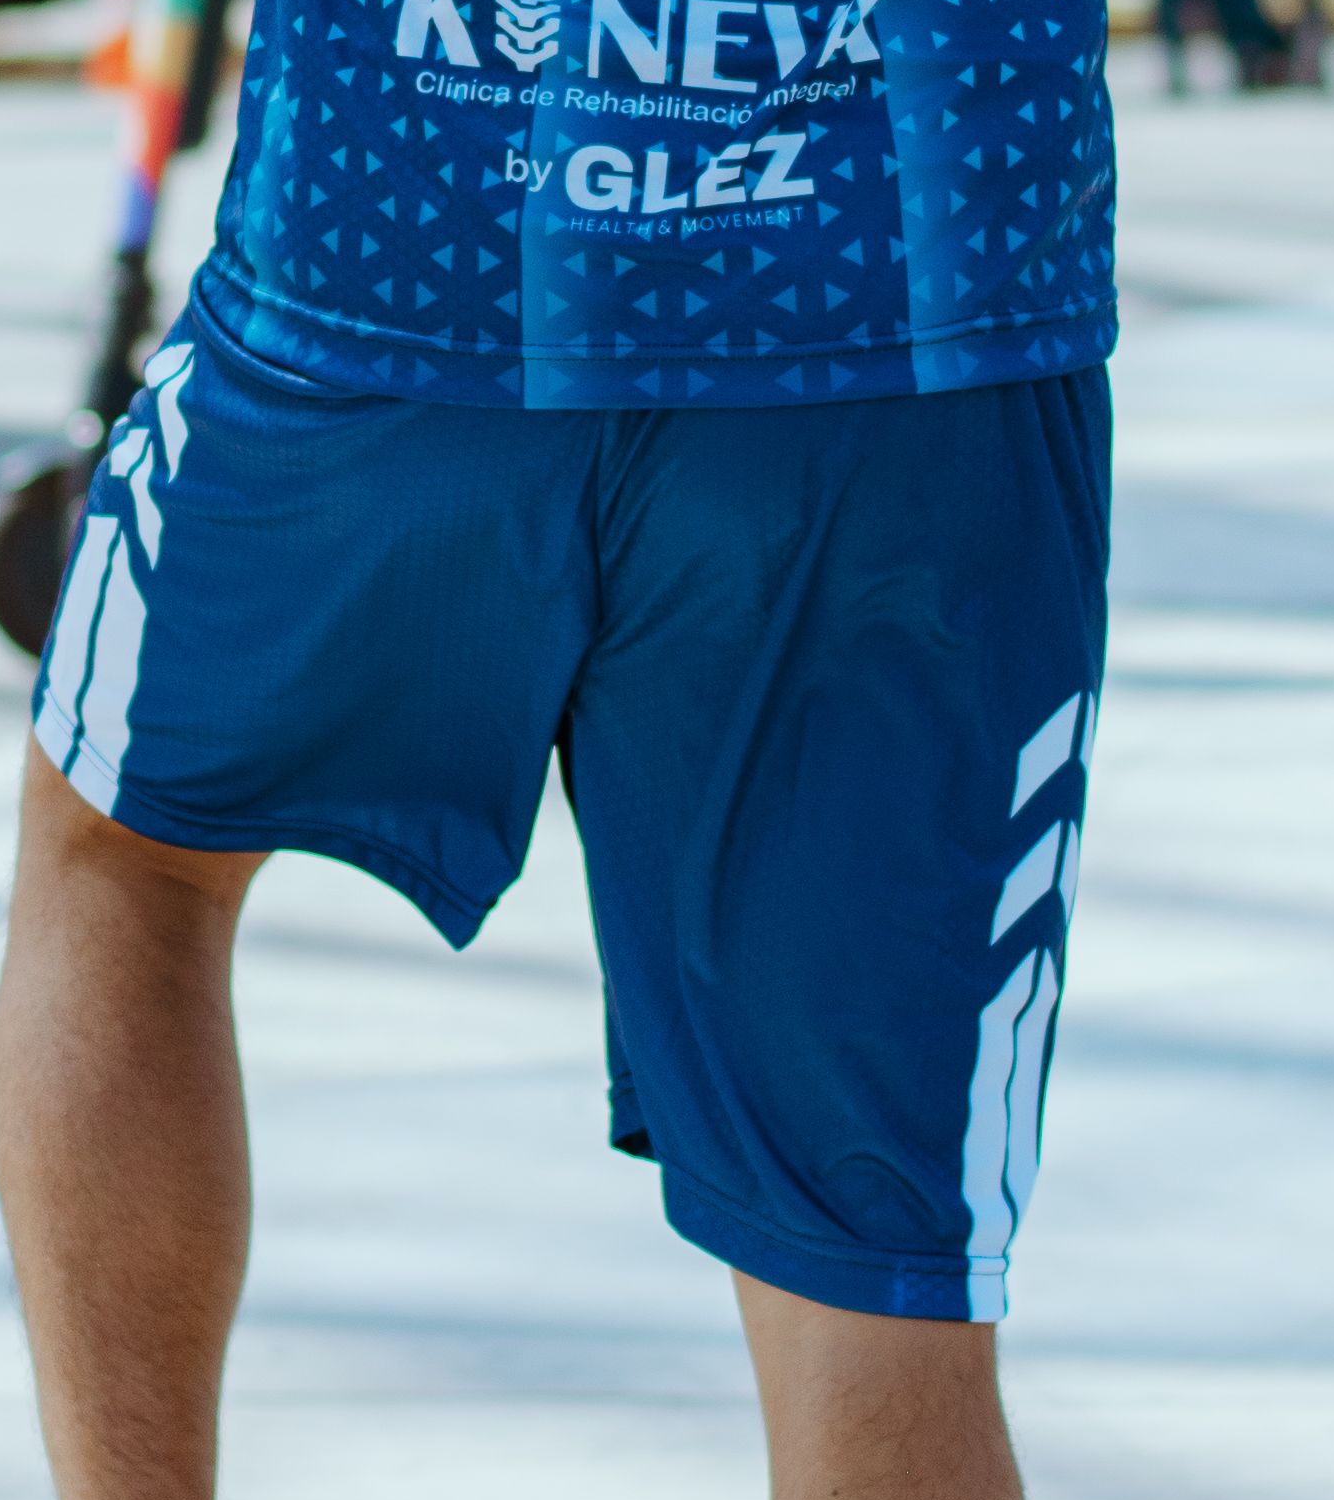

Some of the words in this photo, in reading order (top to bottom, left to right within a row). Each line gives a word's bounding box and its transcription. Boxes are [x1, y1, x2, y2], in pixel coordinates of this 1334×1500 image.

[416, 71, 511, 103] Clínica
[520, 84, 555, 107] de
[564, 87, 754, 124] Rehabilitació
[505, 150, 553, 192] by
[565, 133, 815, 213] GLEZ
[571, 216, 651, 234] HEALTH
[658, 220, 672, 235] &
[681, 206, 804, 233] MOVEMENT
